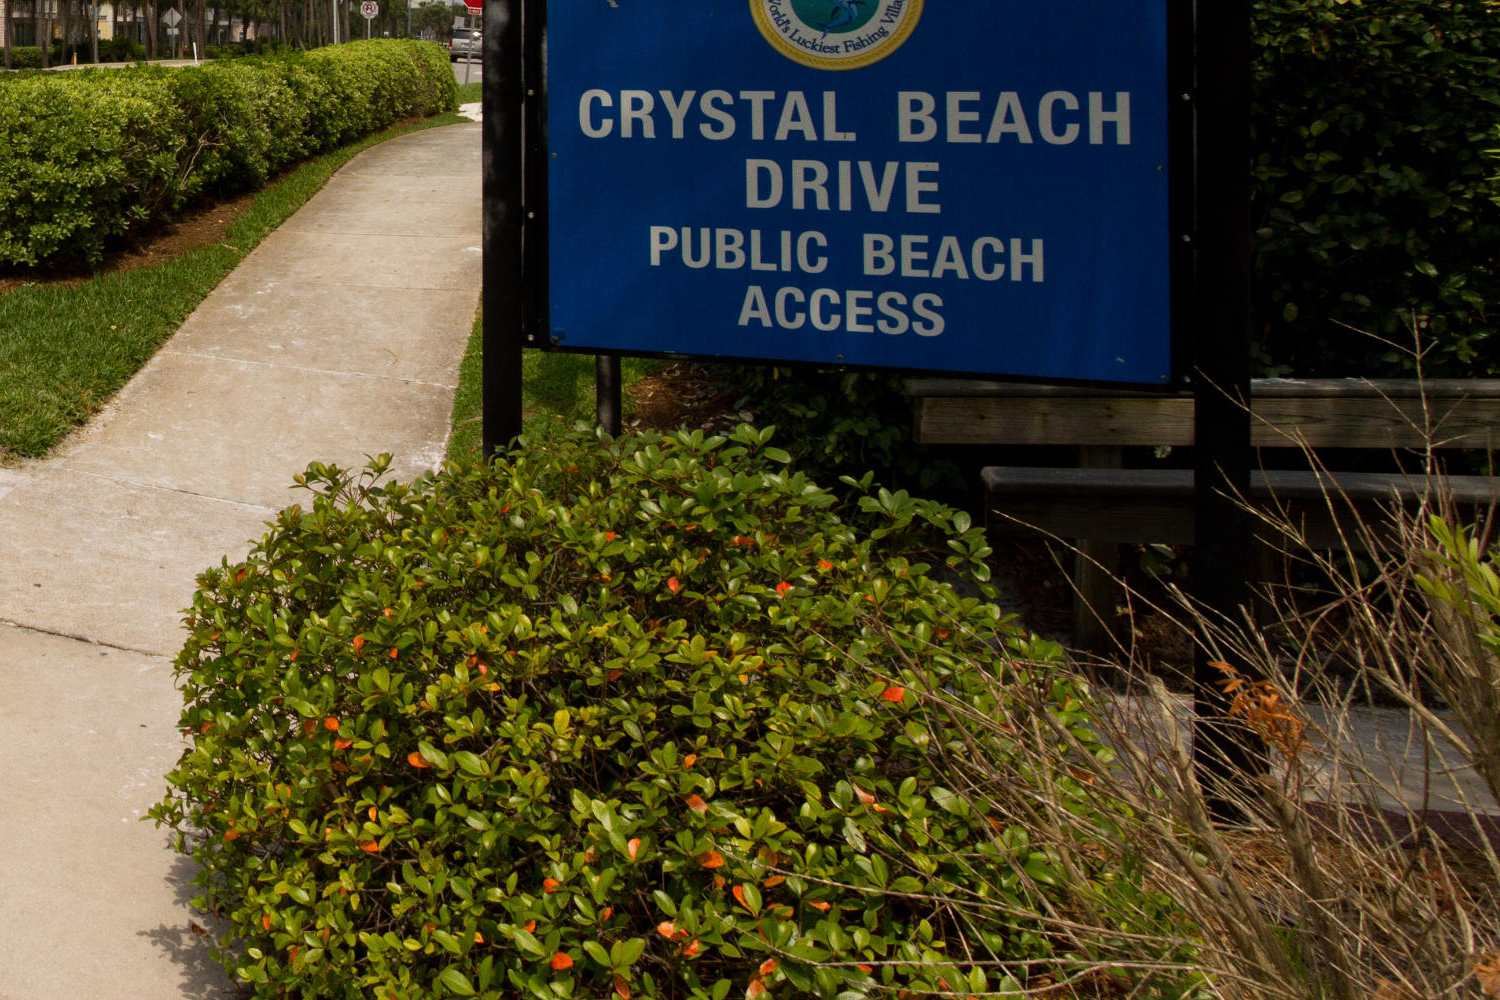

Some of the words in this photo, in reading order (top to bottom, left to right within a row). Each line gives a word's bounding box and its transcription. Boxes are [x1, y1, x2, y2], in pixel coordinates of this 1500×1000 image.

[789, 28, 841, 53] Luckiest
[843, 25, 890, 53] Fishing
[580, 89, 856, 141] CRYSTAL
[899, 91, 1130, 144] BEACH
[746, 159, 940, 213] DRIVE
[651, 226, 828, 273] PUBLIC
[864, 234, 1043, 281] BEACH
[739, 286, 944, 336] ACCESS
